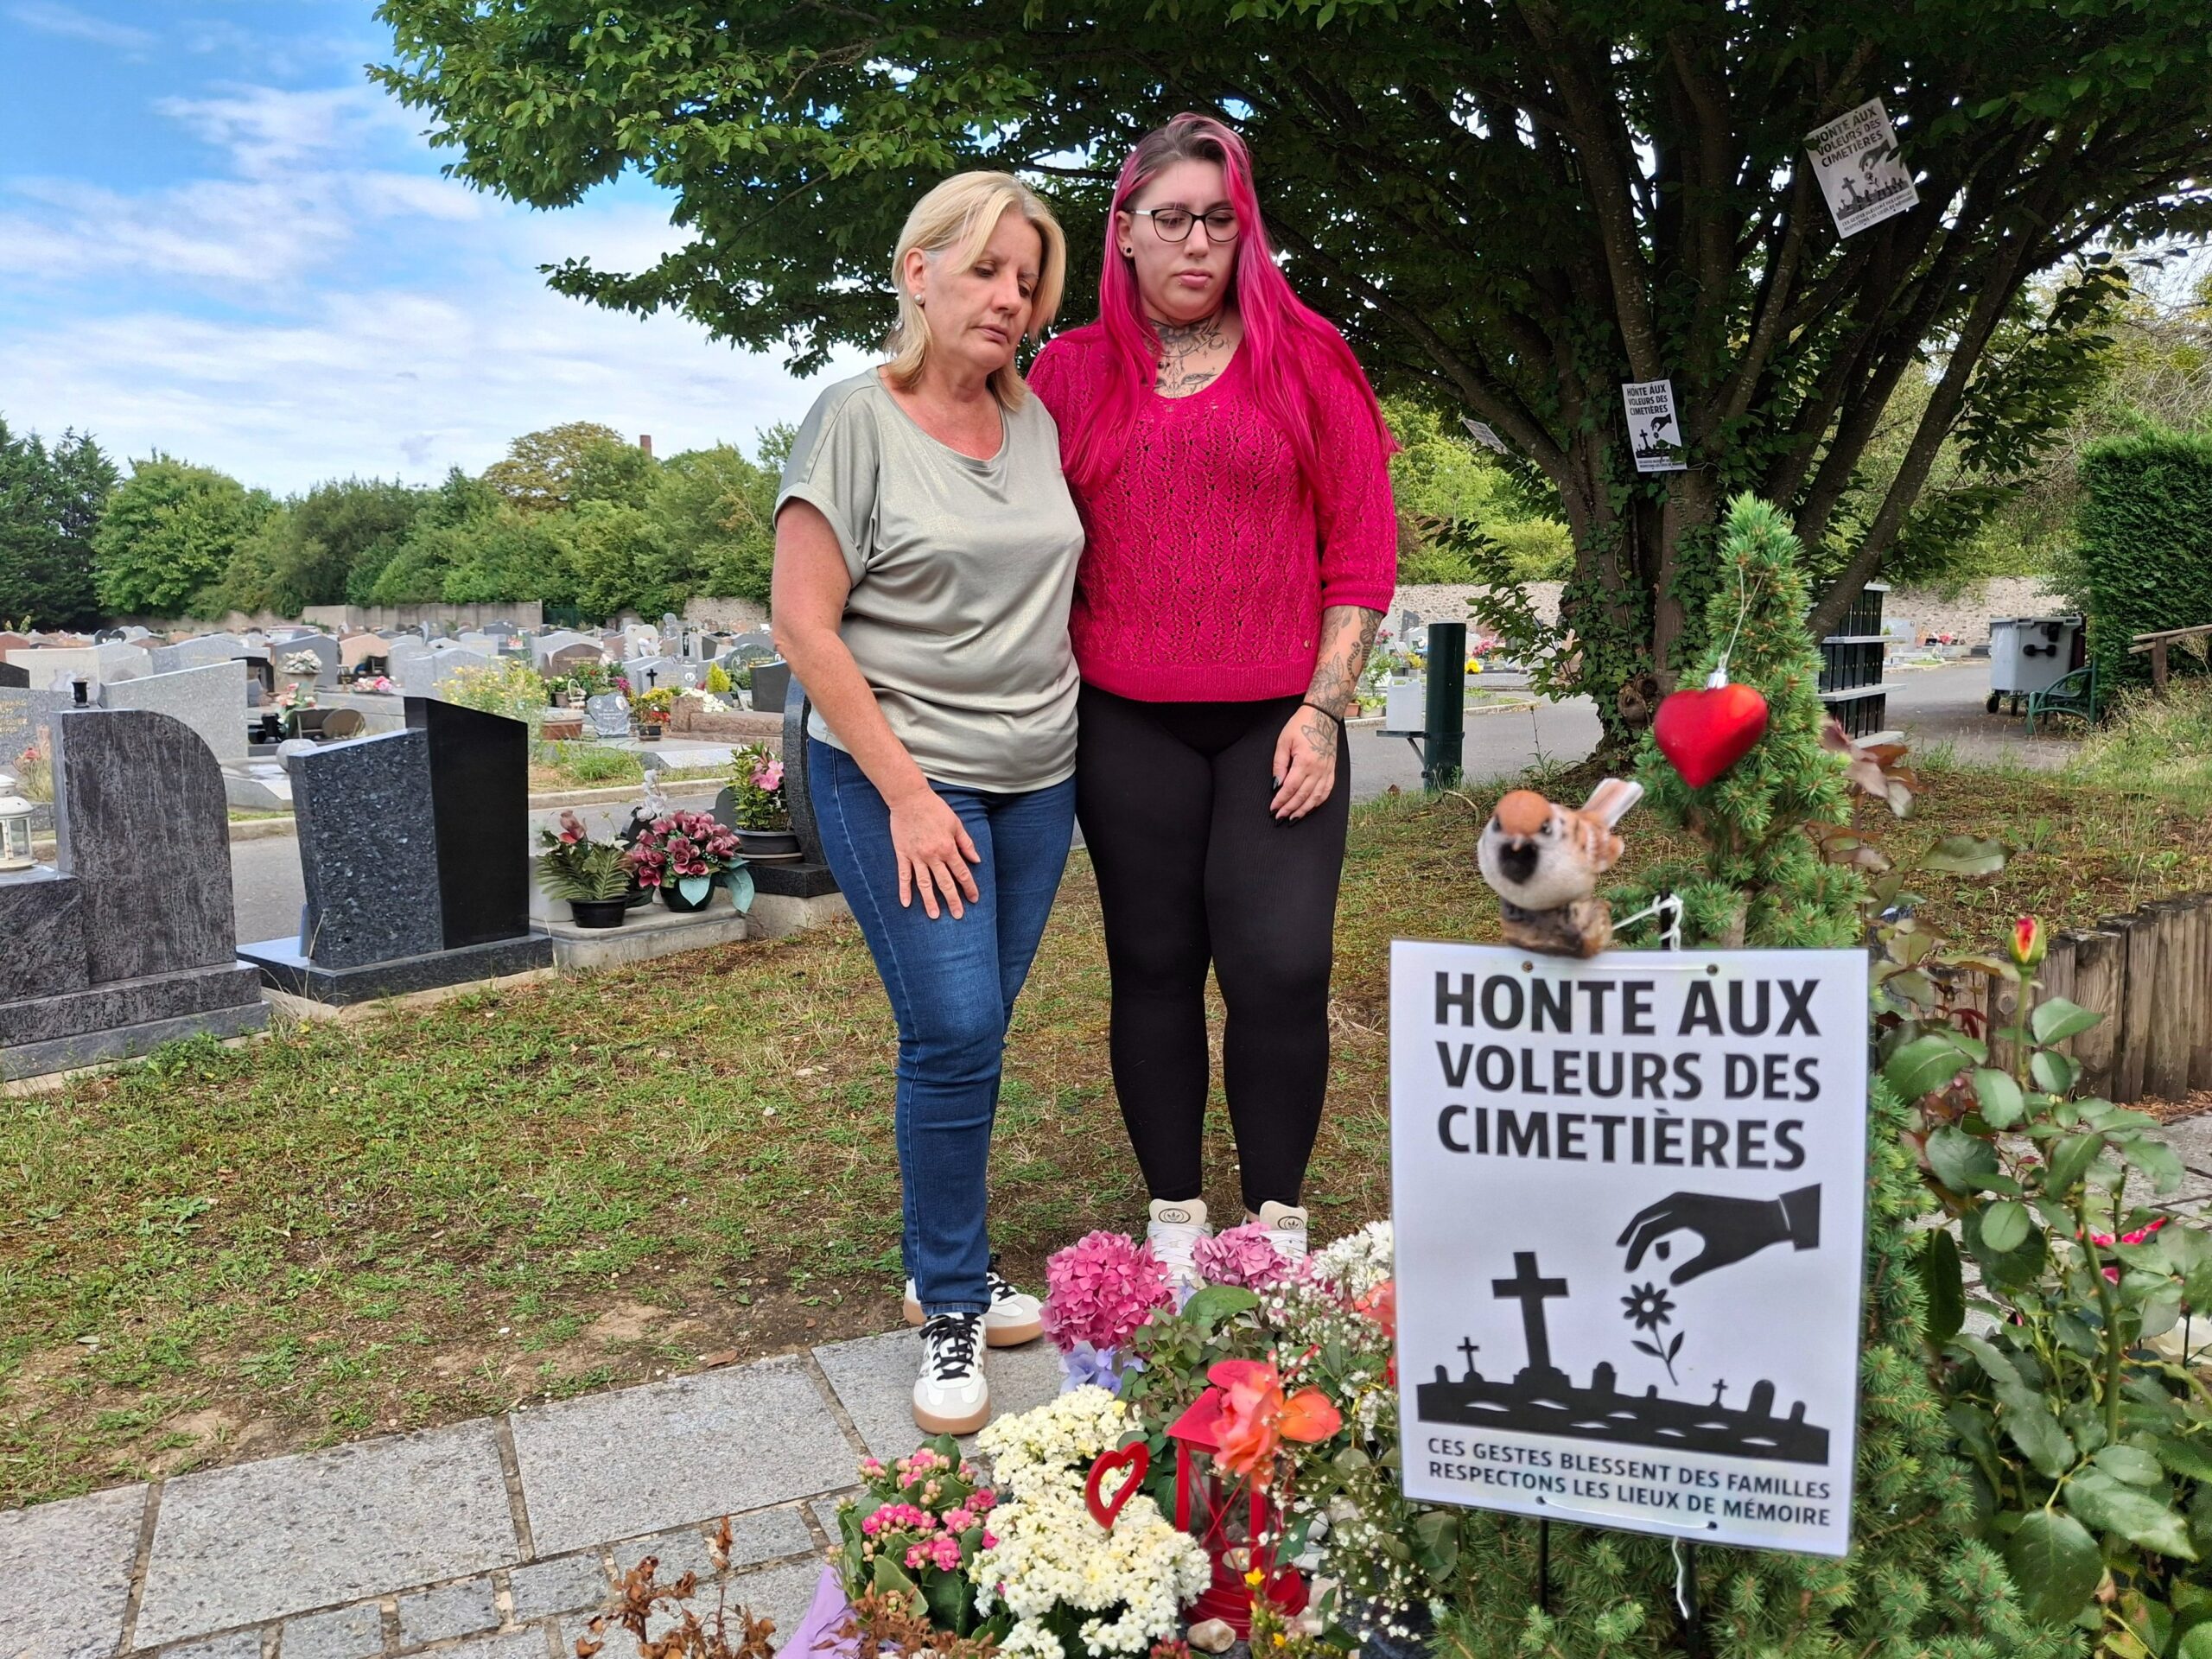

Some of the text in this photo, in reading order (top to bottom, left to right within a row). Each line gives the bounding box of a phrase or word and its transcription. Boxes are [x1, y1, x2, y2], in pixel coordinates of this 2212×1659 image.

[1817, 118, 1881, 156] VOLEURS DES
[1853, 106, 1878, 126] AUX
[1627, 385, 1666, 397] HONTE AUX
[1628, 397, 1655, 405] VOLEURS
[1434, 971, 1821, 1036] HONTE AUX
[1435, 1040, 1820, 1102] VOLEURS DES
[1438, 1104, 1805, 1171] CIMETIÈRES
[1427, 1437, 1830, 1499] CES GESTES BLESSENT DES FAMILLES
[1428, 1461, 1830, 1526] RESPECTONS LES LIEUX DE MÉMOIRE
